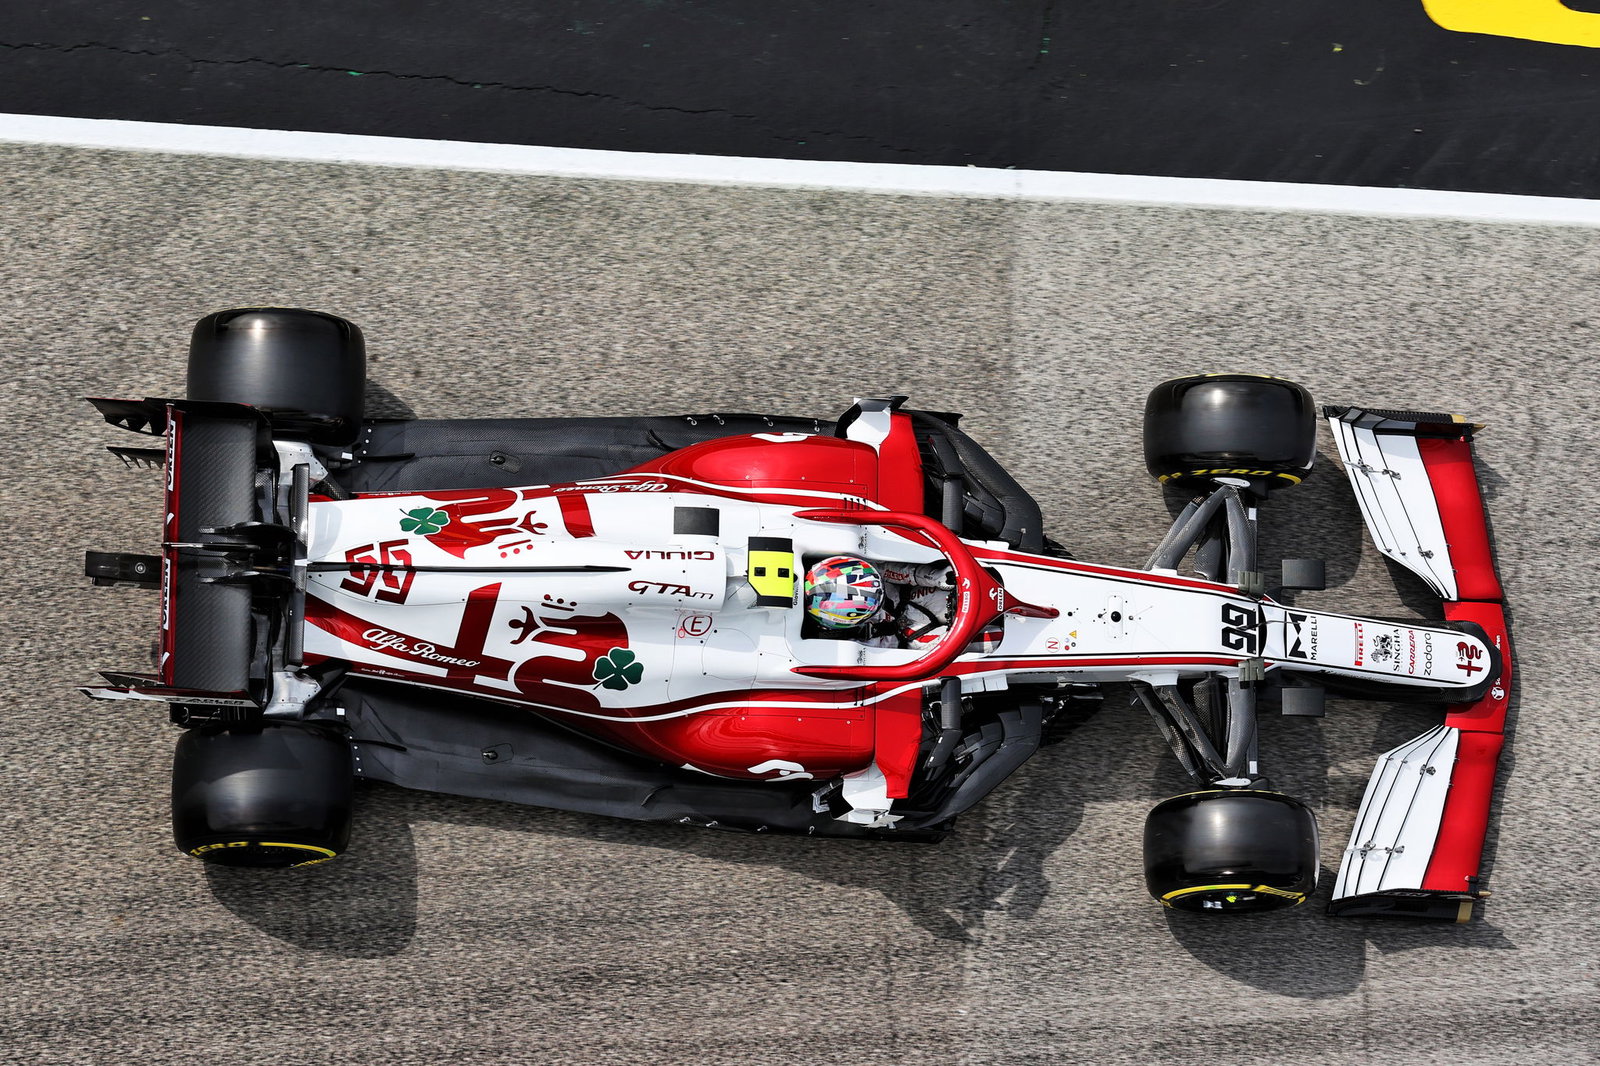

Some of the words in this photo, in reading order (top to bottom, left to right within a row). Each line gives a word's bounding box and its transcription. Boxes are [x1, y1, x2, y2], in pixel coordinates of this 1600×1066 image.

[624, 480, 668, 492] Alfa
[1190, 468, 1273, 476] ZERO
[623, 550, 715, 560] GIULIA
[690, 616, 705, 632] E
[1221, 602, 1257, 655] 99
[1310, 616, 1318, 661] MARELLI
[362, 628, 410, 651] Alfa
[409, 642, 481, 668] Romeo
[1047, 640, 1058, 650] N
[1354, 623, 1364, 666] PIRELLI
[1393, 628, 1401, 672] SINGHA
[1408, 630, 1416, 675] CARRERA
